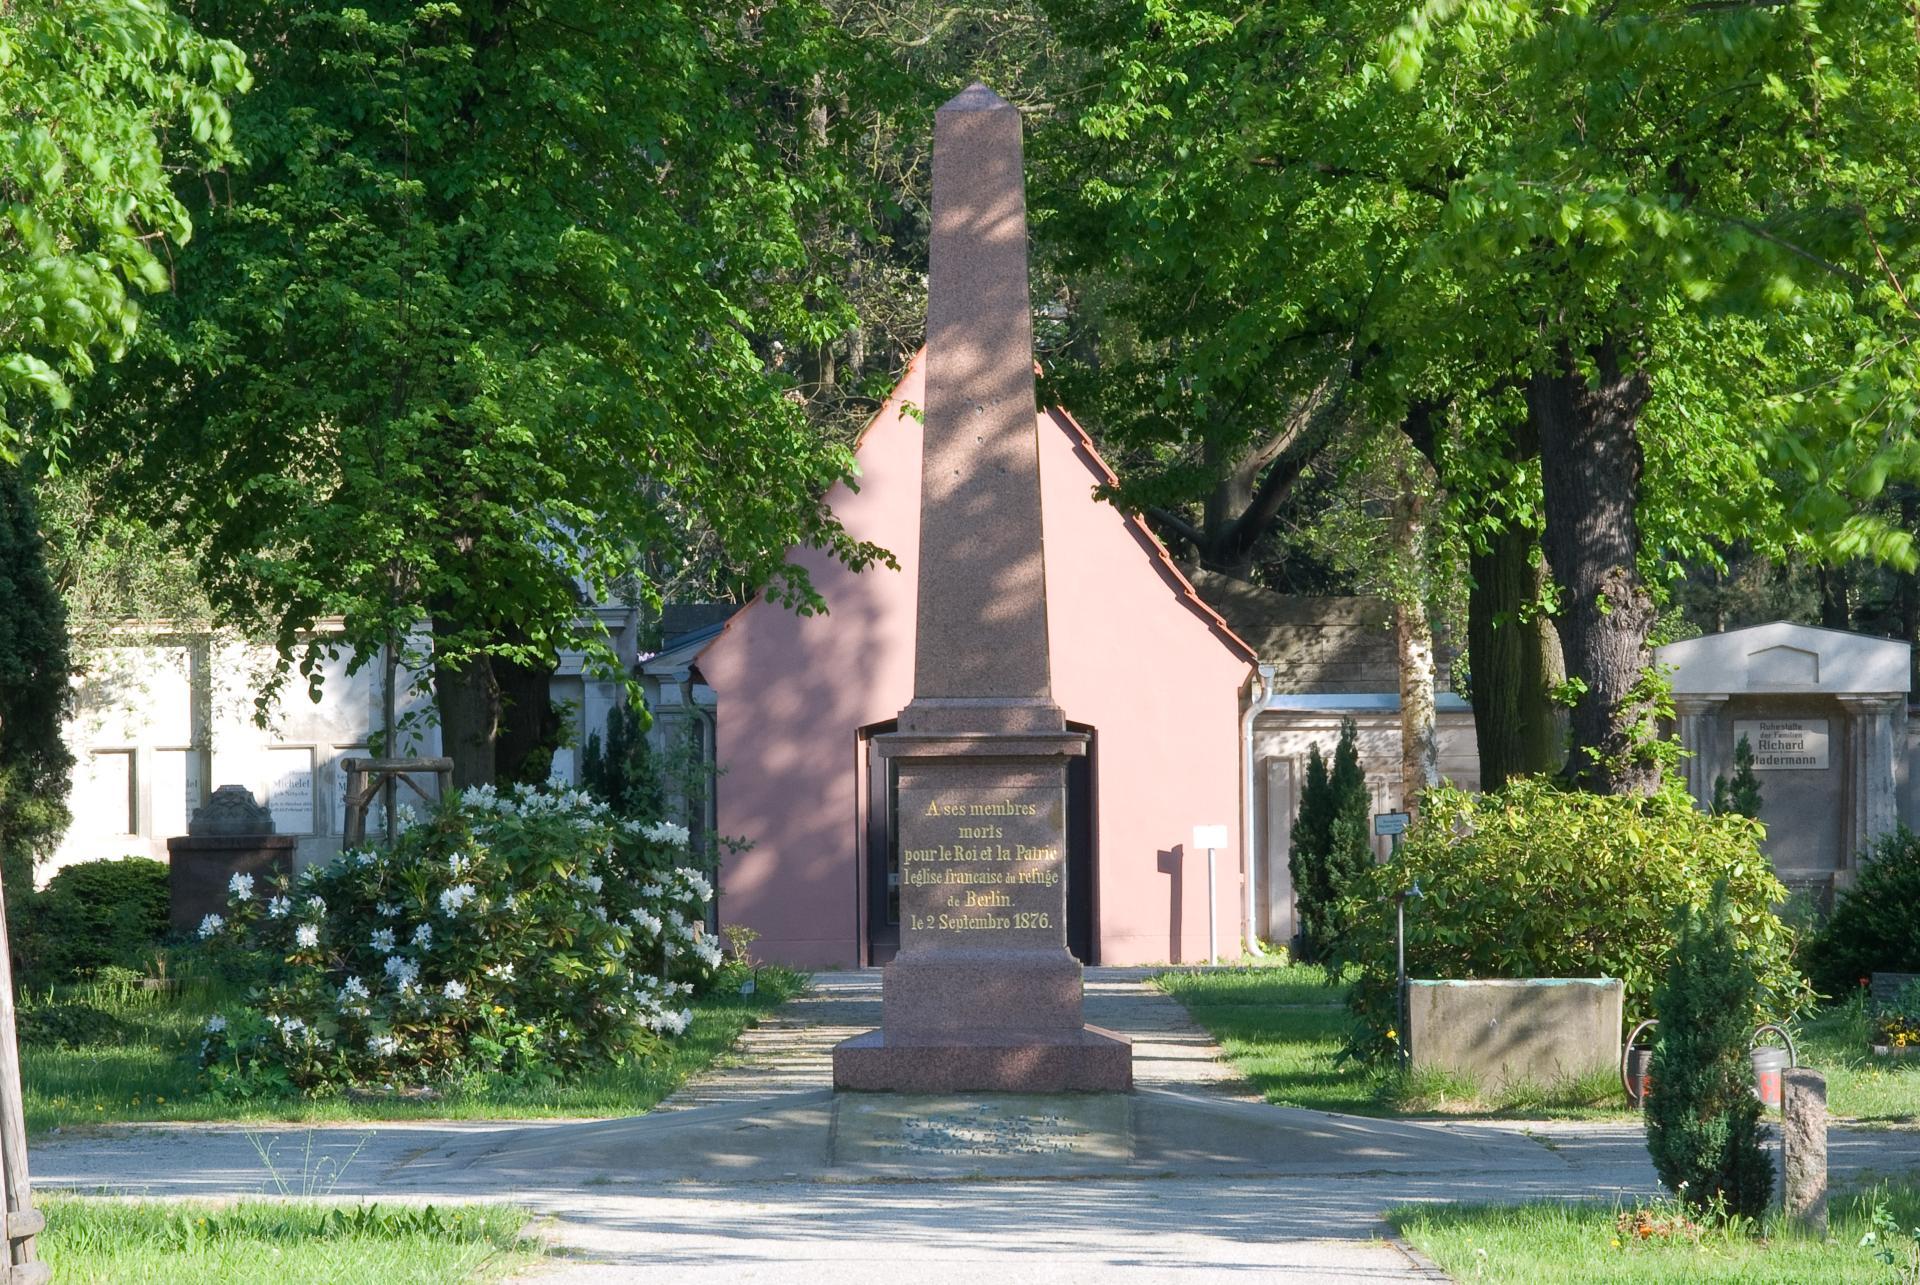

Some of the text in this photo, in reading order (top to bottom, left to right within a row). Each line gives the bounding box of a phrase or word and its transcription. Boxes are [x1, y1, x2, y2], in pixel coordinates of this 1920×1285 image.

[1759, 740, 1804, 750] Richard
[1751, 755, 1816, 765] tadermann
[925, 800, 1036, 817] A ses membres
[959, 824, 1003, 839] morts
[904, 845, 1057, 865] pour le Roi et la Patrie
[1005, 873, 1016, 884] du
[1018, 868, 1059, 887] refuge
[947, 890, 1016, 907] de Berlin.
[911, 913, 1053, 933] le 2 Septembre 1876.
